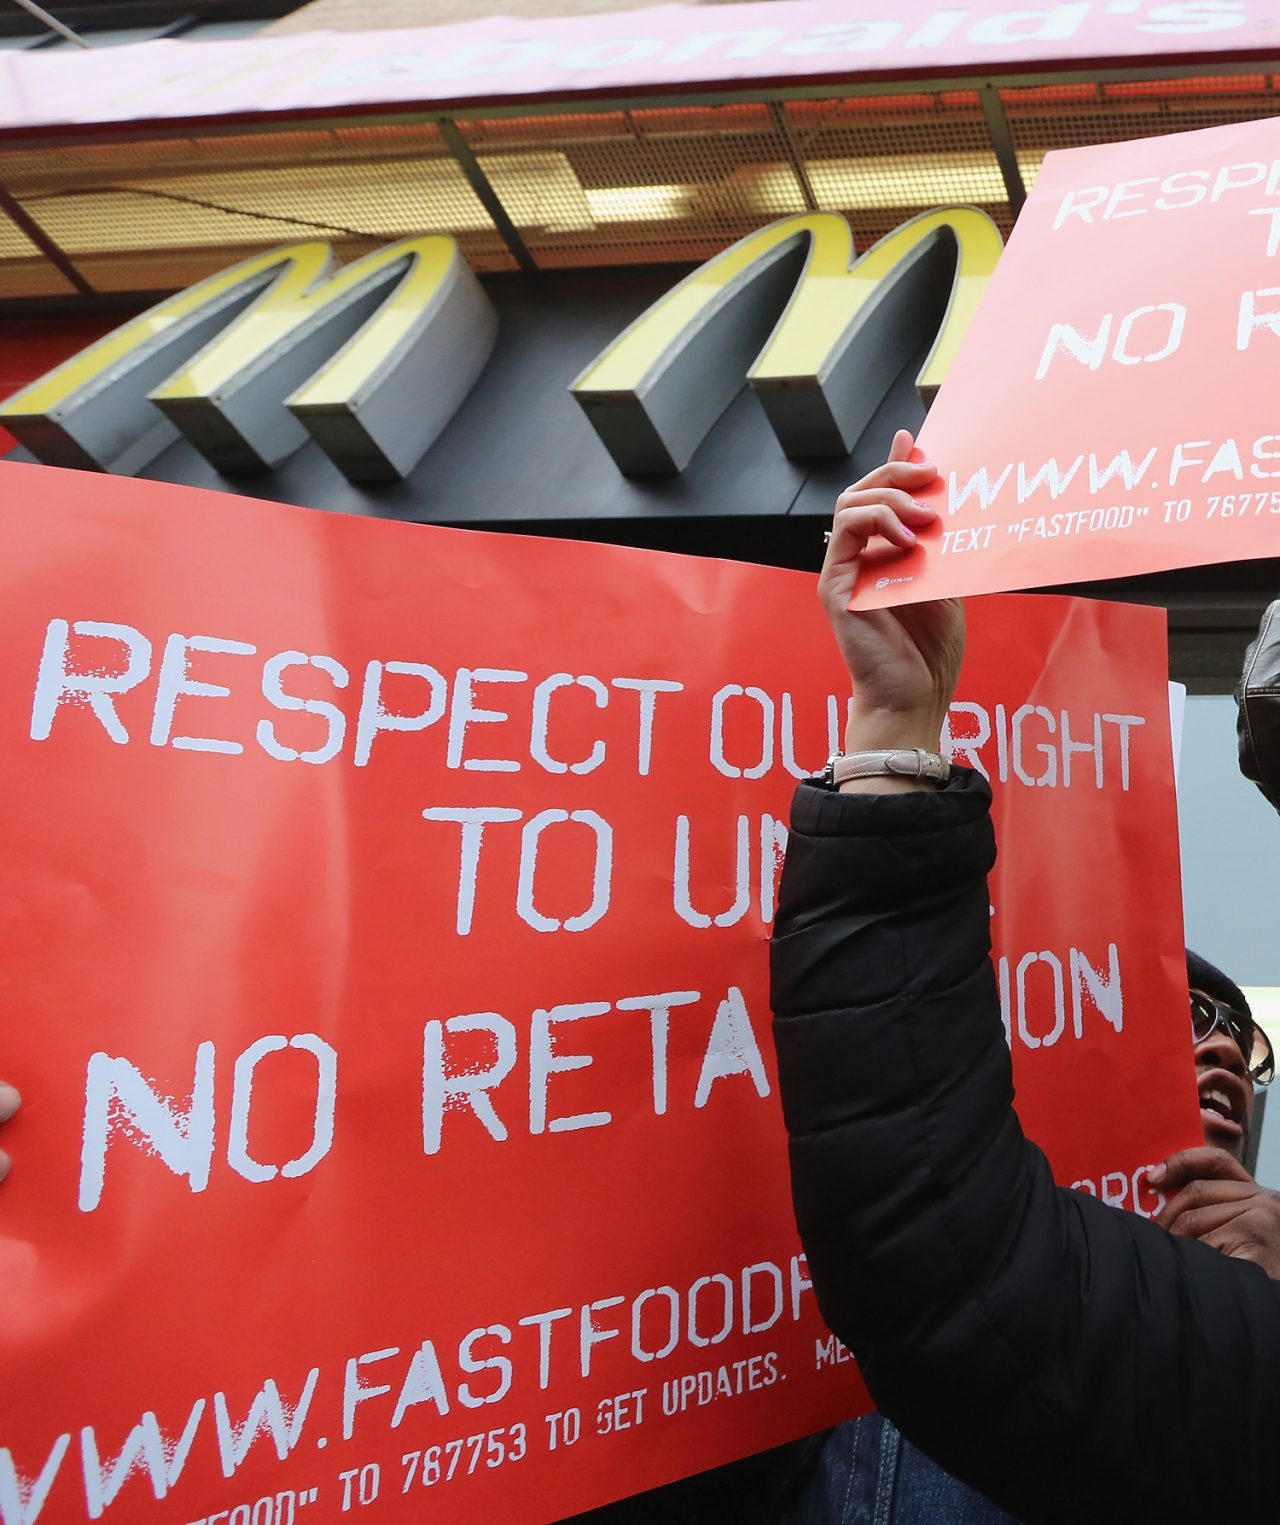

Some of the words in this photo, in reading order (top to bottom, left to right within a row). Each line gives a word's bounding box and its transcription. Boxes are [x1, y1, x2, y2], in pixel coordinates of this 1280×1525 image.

[1035, 302, 1187, 381] NO
[940, 525, 997, 556] TEXT
[1163, 499, 1193, 524] TO
[29, 617, 685, 776] RESPECT
[709, 683, 853, 780] OU
[939, 700, 1146, 791] RIGHT
[421, 806, 613, 935] TO
[78, 1032, 338, 1213] NO
[338, 1462, 381, 1512] TO
[402, 1423, 527, 1494] 787753
[545, 1407, 581, 1451] TO
[597, 1388, 648, 1434] GET
[662, 1351, 787, 1416] UPDATES.
